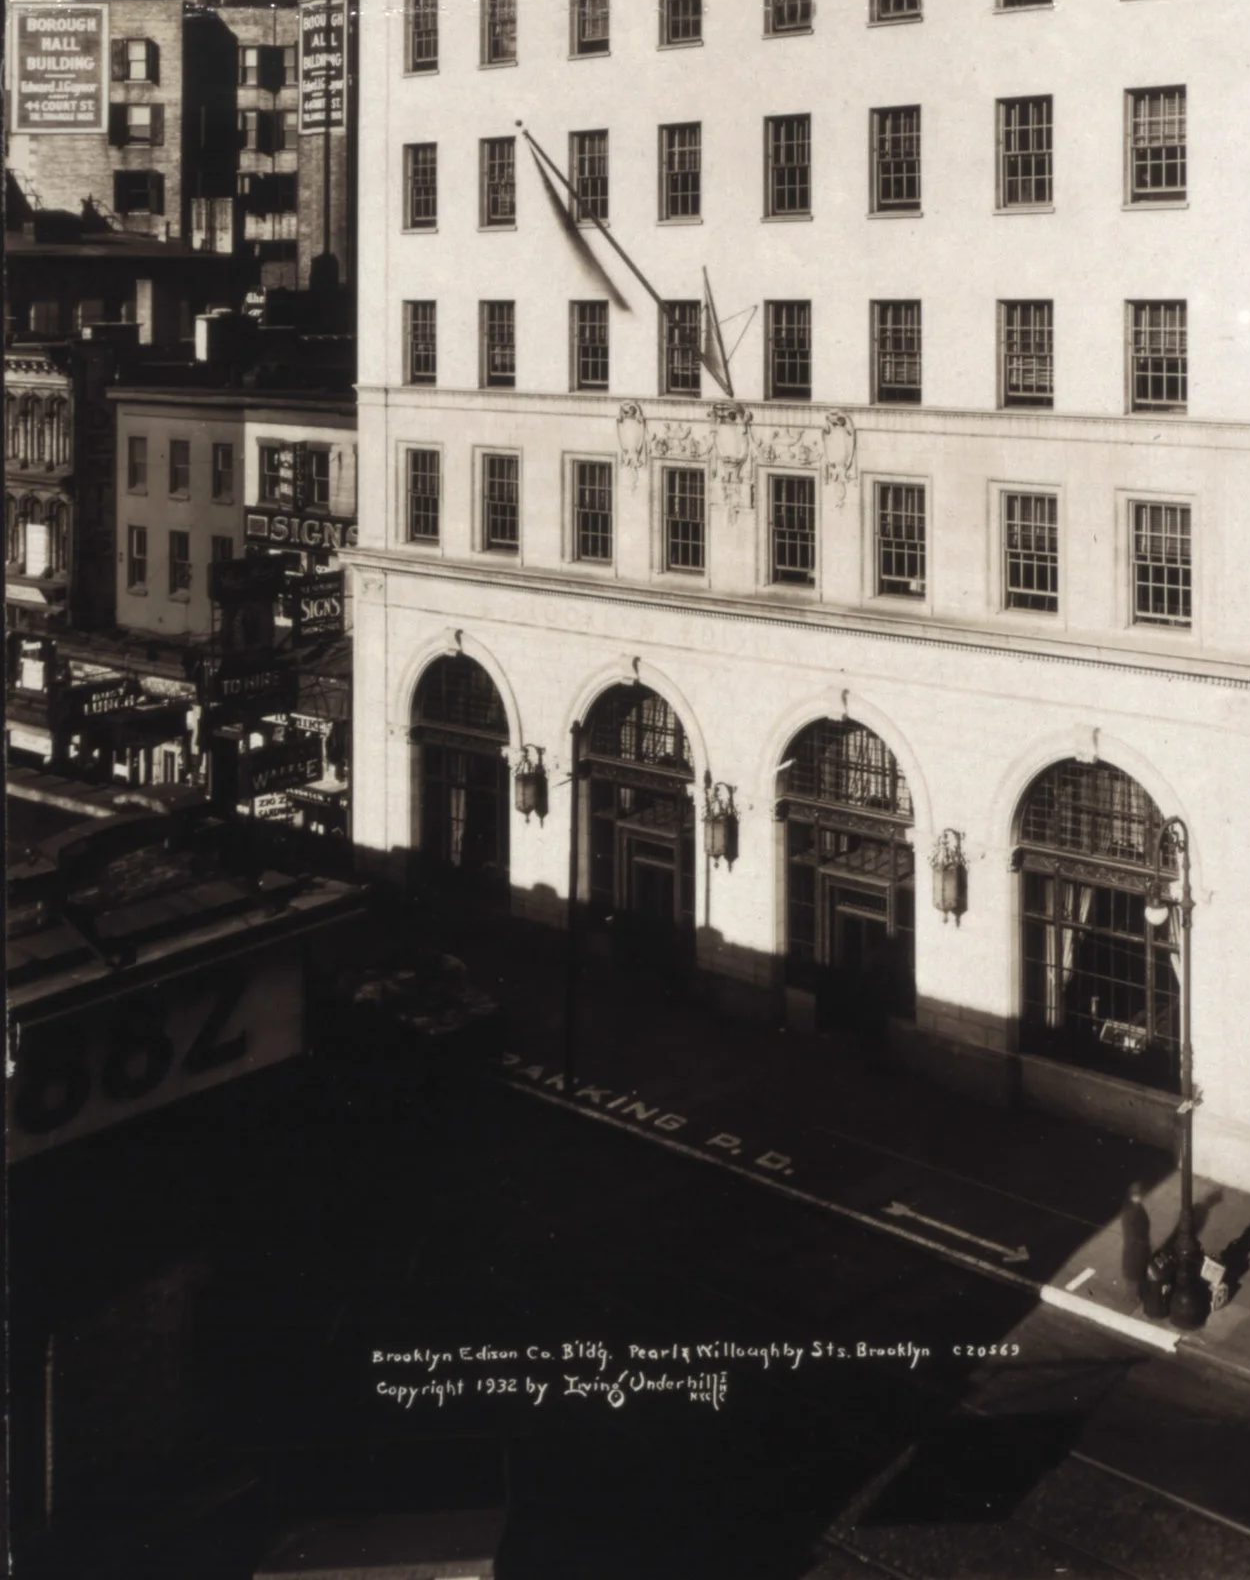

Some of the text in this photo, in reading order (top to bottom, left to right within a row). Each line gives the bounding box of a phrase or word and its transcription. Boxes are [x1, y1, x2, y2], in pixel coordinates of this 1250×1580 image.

[26, 17, 97, 32] BOROUGH
[40, 37, 81, 52] HALL
[26, 56, 96, 71] BUILDING
[41, 100, 78, 111] COURT
[300, 592, 341, 622] SIGNS
